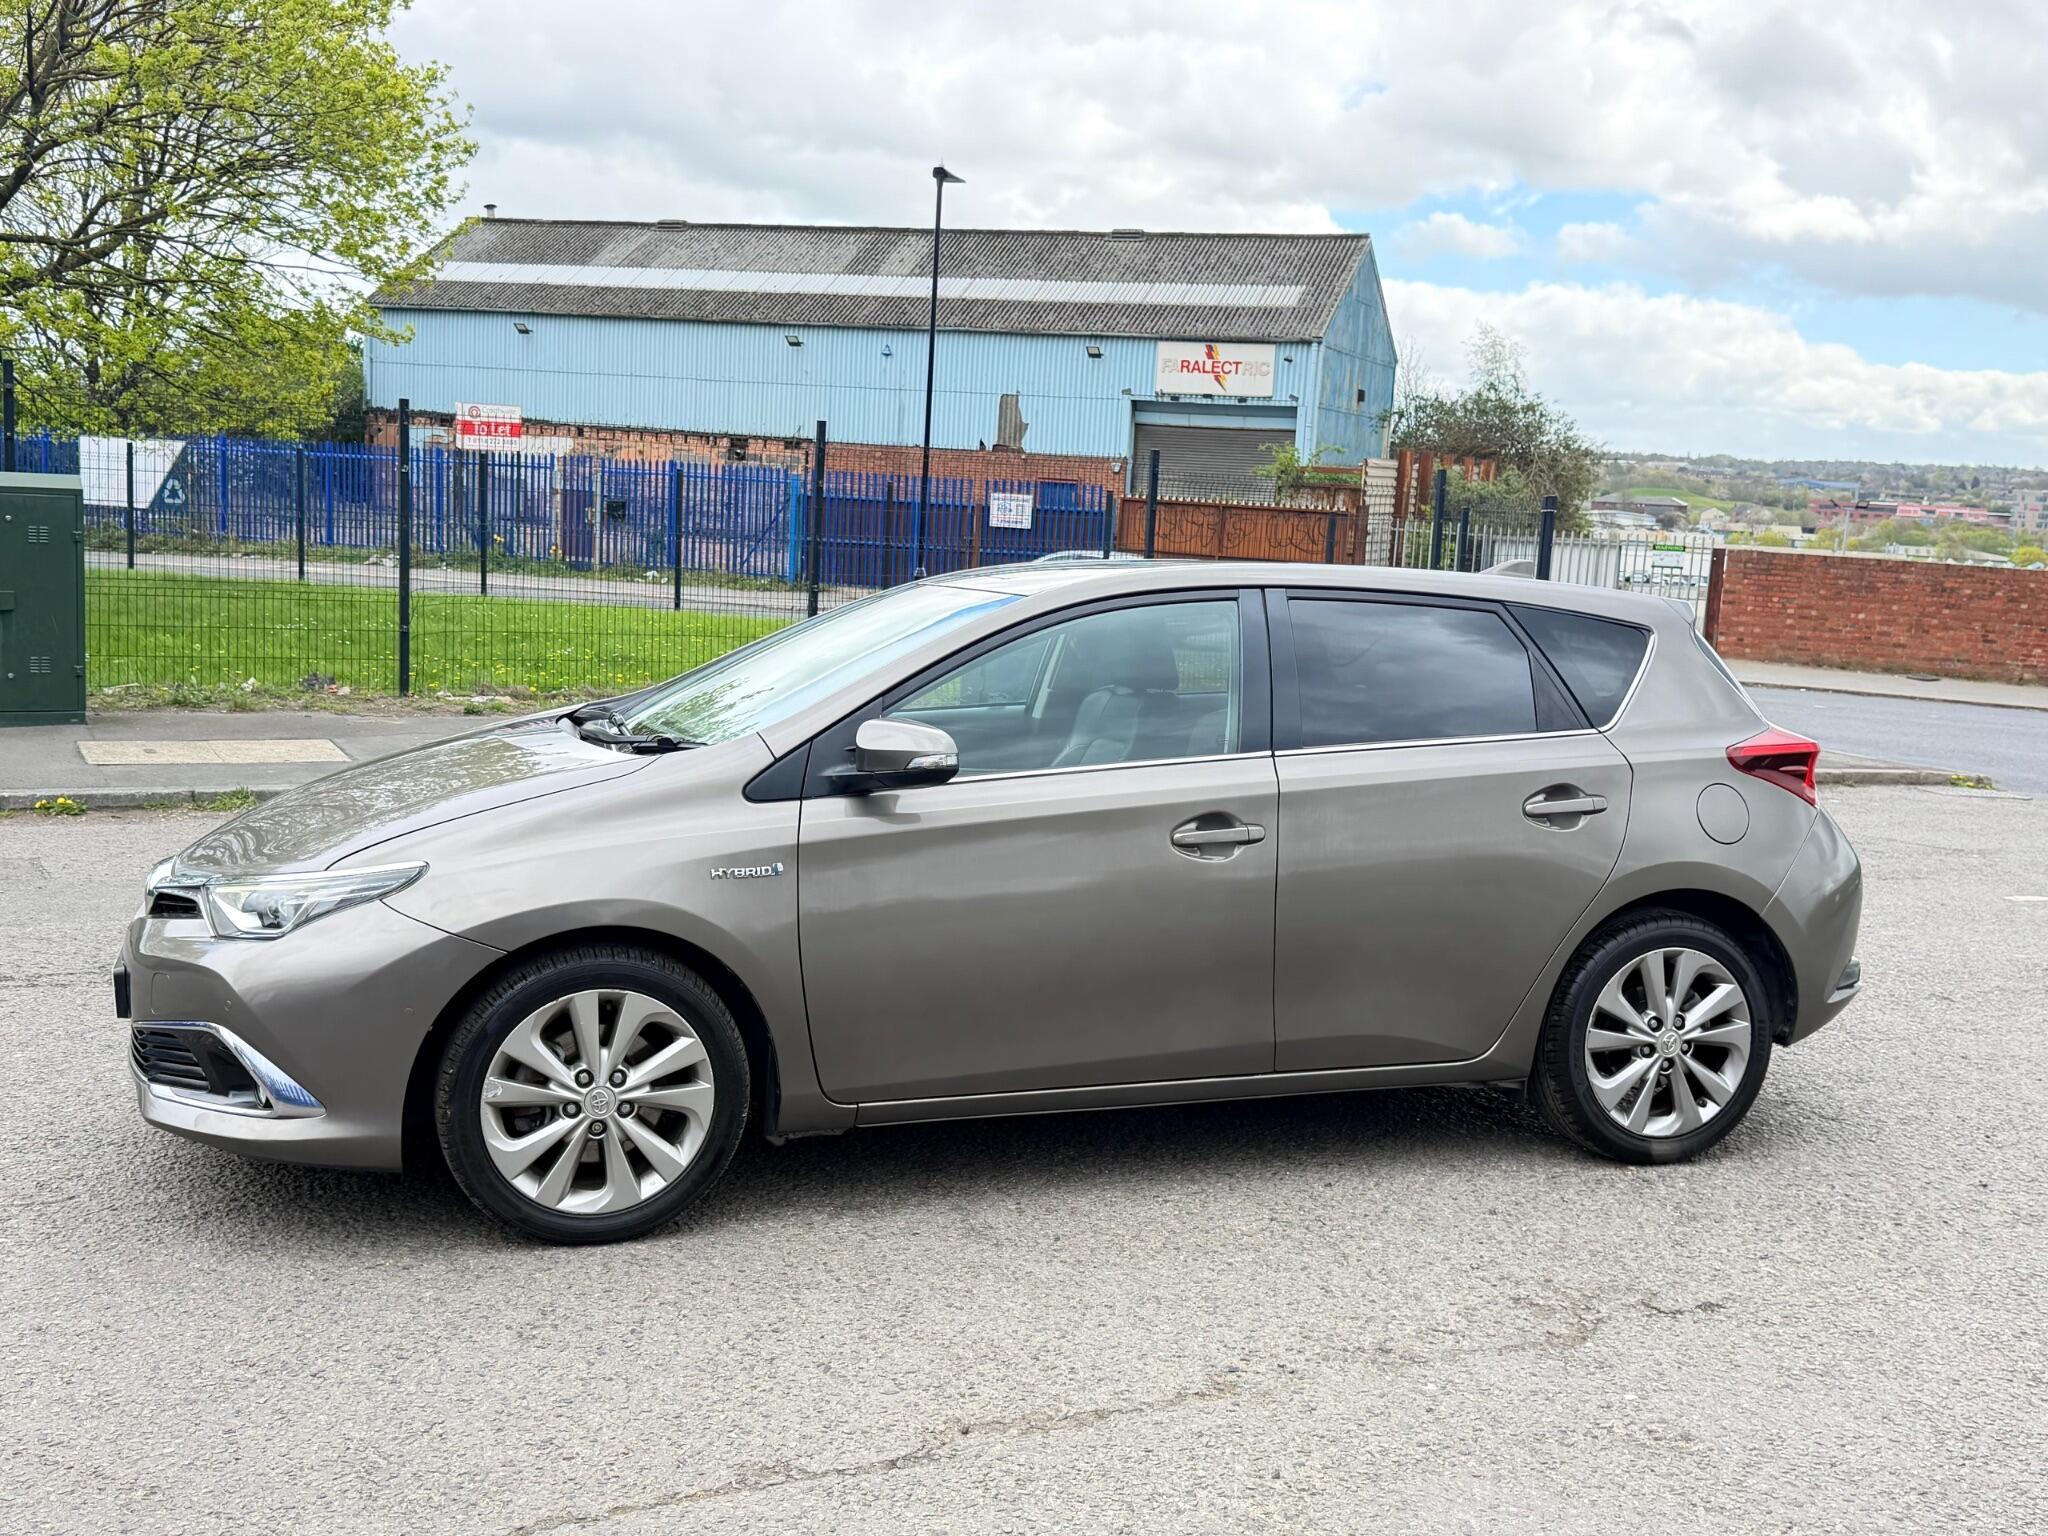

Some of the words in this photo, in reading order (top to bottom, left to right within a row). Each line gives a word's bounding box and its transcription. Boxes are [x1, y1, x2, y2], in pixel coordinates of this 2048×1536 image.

[472, 421, 488, 435] To
[491, 423, 511, 436] Let
[710, 866, 772, 878] HYBRID
